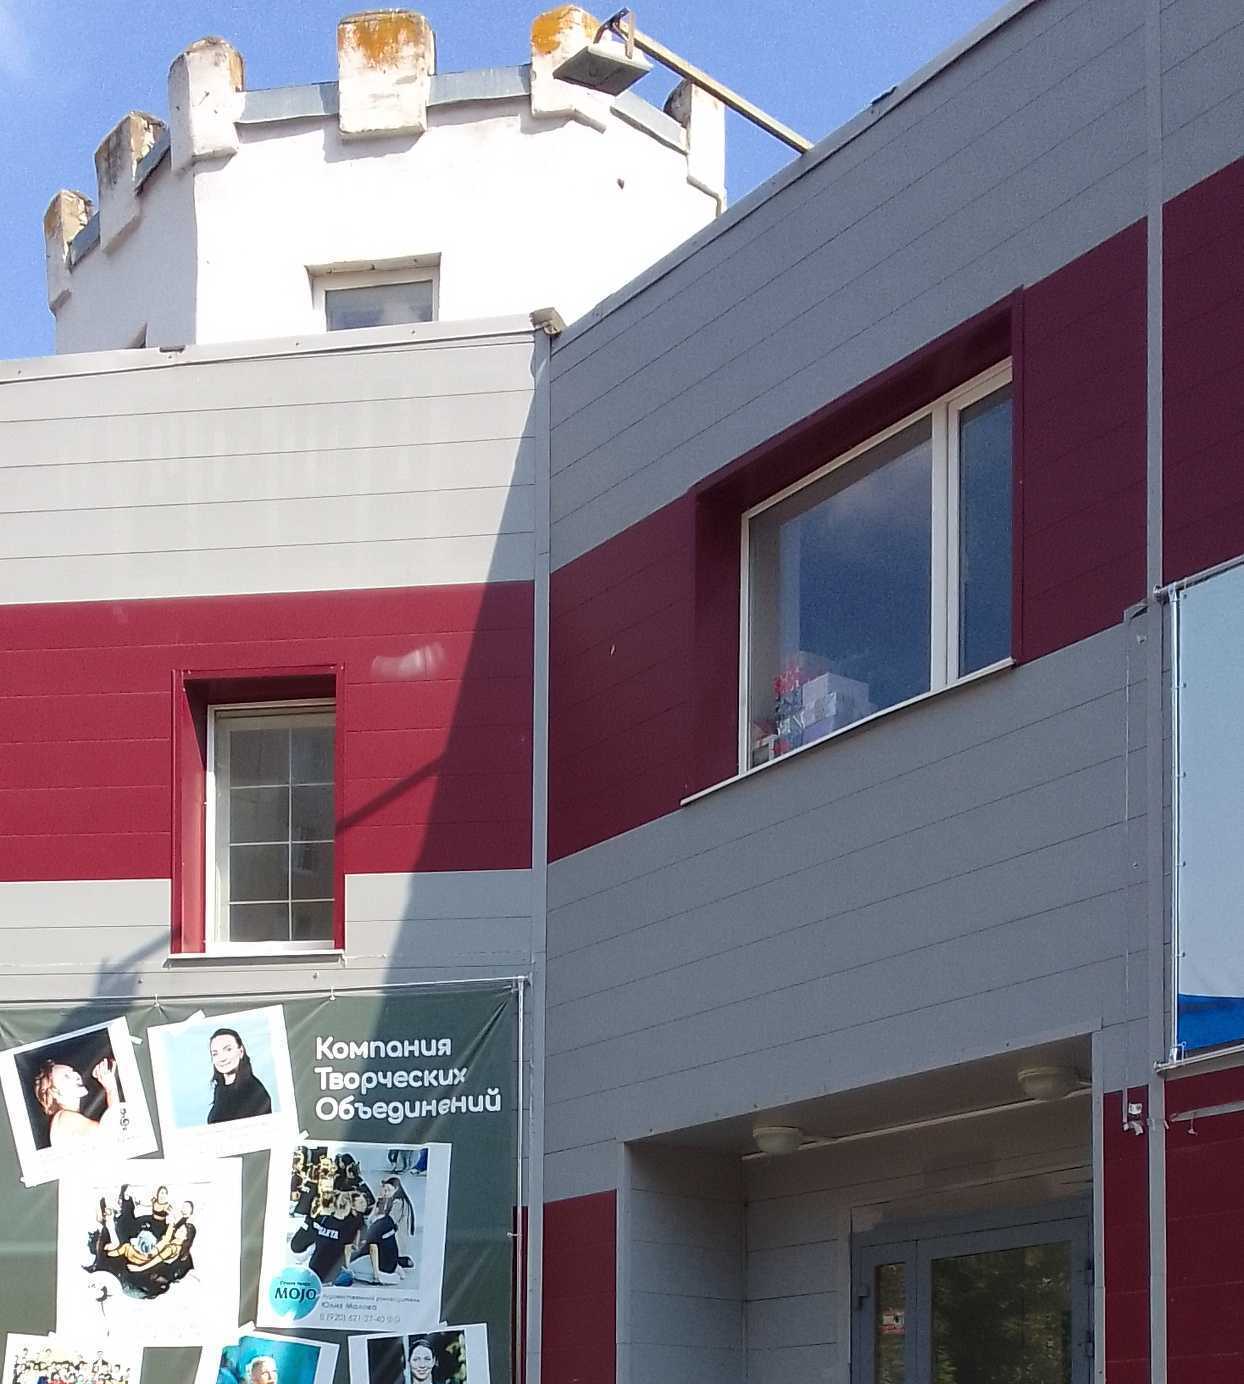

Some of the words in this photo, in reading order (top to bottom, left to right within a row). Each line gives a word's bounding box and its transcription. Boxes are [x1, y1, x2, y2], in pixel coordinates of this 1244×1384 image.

[315, 1036, 452, 1060] Компания
[314, 1066, 468, 1095] Творческих
[315, 1087, 502, 1124] Объединений
[274, 1286, 318, 1303] MOJO
